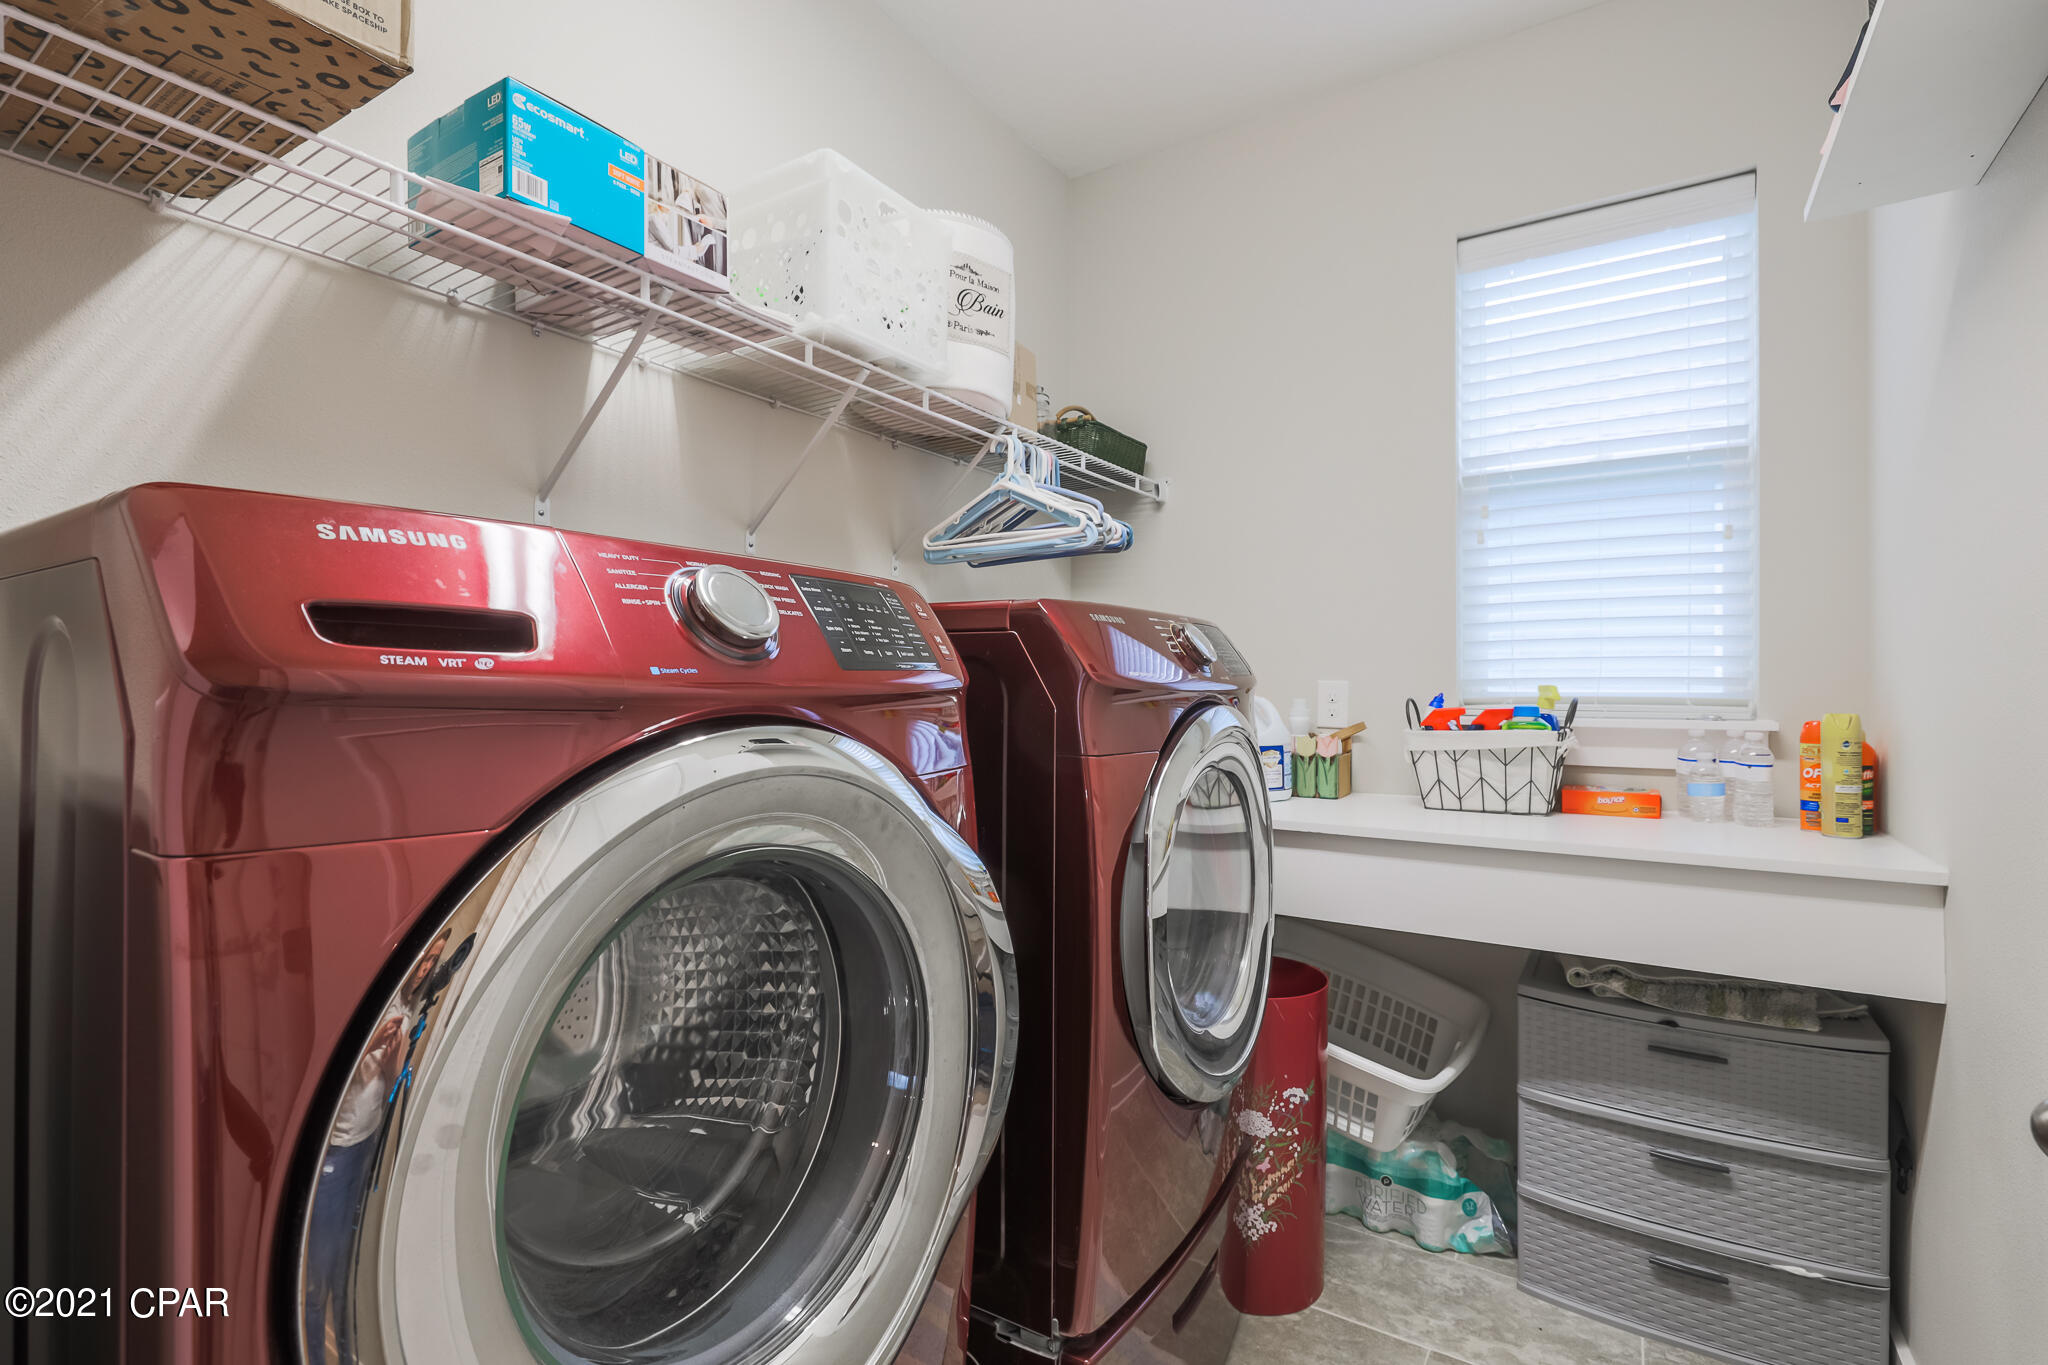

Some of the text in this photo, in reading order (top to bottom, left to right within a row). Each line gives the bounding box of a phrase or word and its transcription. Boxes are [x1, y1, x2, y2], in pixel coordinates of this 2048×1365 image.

[341, 6, 388, 34] SPACESHIP
[352, 3, 371, 17] BOX
[373, 12, 385, 24] TO
[487, 91, 501, 109] LED
[526, 101, 585, 140] ecosmart
[619, 148, 639, 166] LED
[949, 269, 1000, 294] Pour la Maison
[954, 288, 1005, 319] Bain
[953, 320, 974, 334] Paris
[315, 523, 468, 550] SAMSUNG
[606, 567, 638, 576] SANITIZE
[614, 582, 649, 591] ALLERGEN
[1089, 613, 1126, 625] SAMSUNG
[380, 654, 428, 667] STEAM
[680, 667, 699, 675] Cycles
[1597, 796, 1625, 805] bounce
[1355, 1176, 1428, 1215] PURIFIED
[1359, 1189, 1416, 1217] WATER
